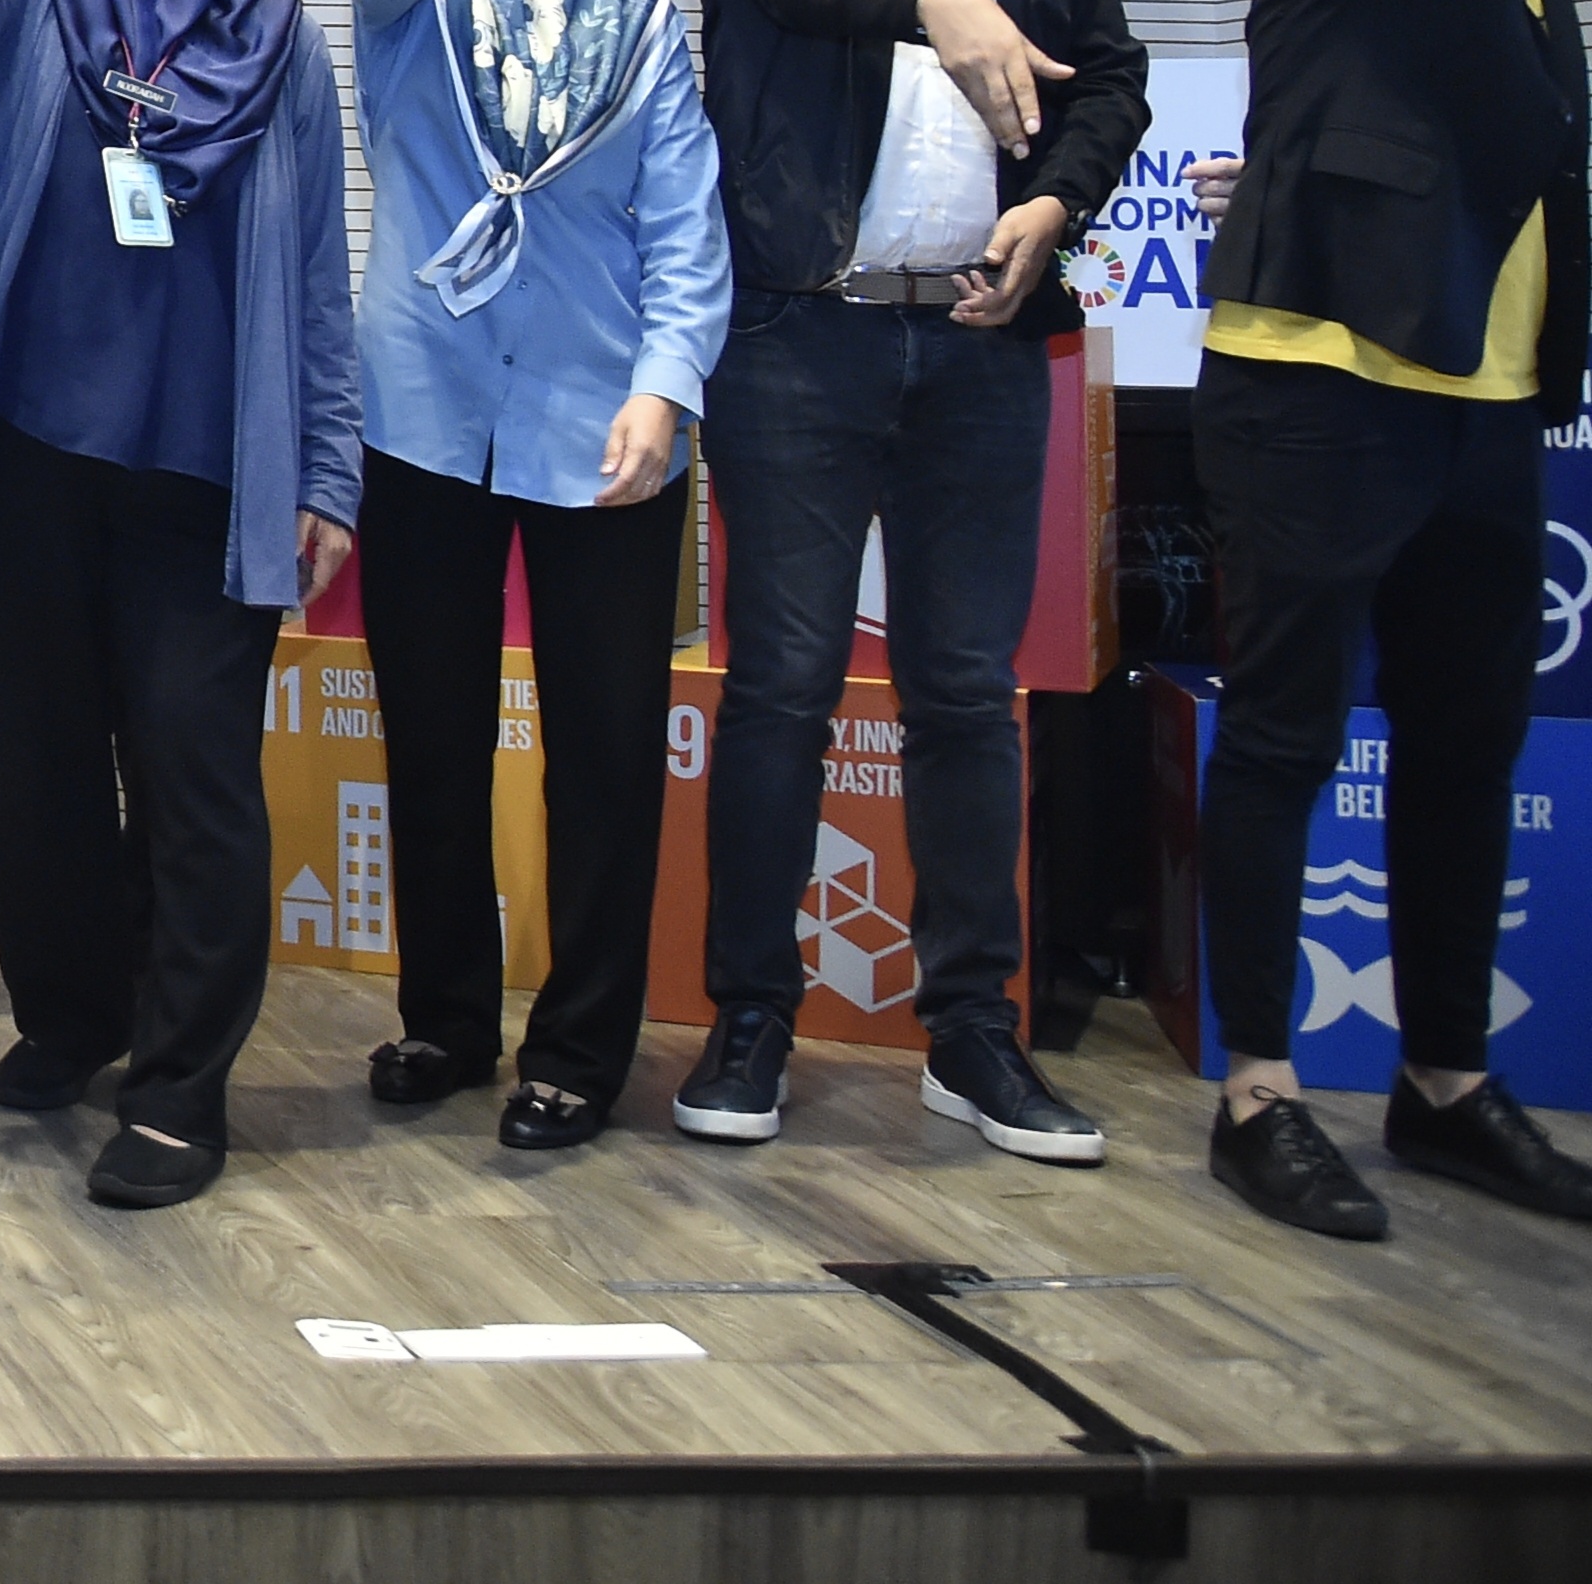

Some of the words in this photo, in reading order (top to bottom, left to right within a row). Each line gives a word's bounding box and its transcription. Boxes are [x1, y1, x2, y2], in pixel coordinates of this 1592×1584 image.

[320, 667, 378, 701] SUST
[320, 706, 368, 739] AND
[666, 703, 706, 780] 9
